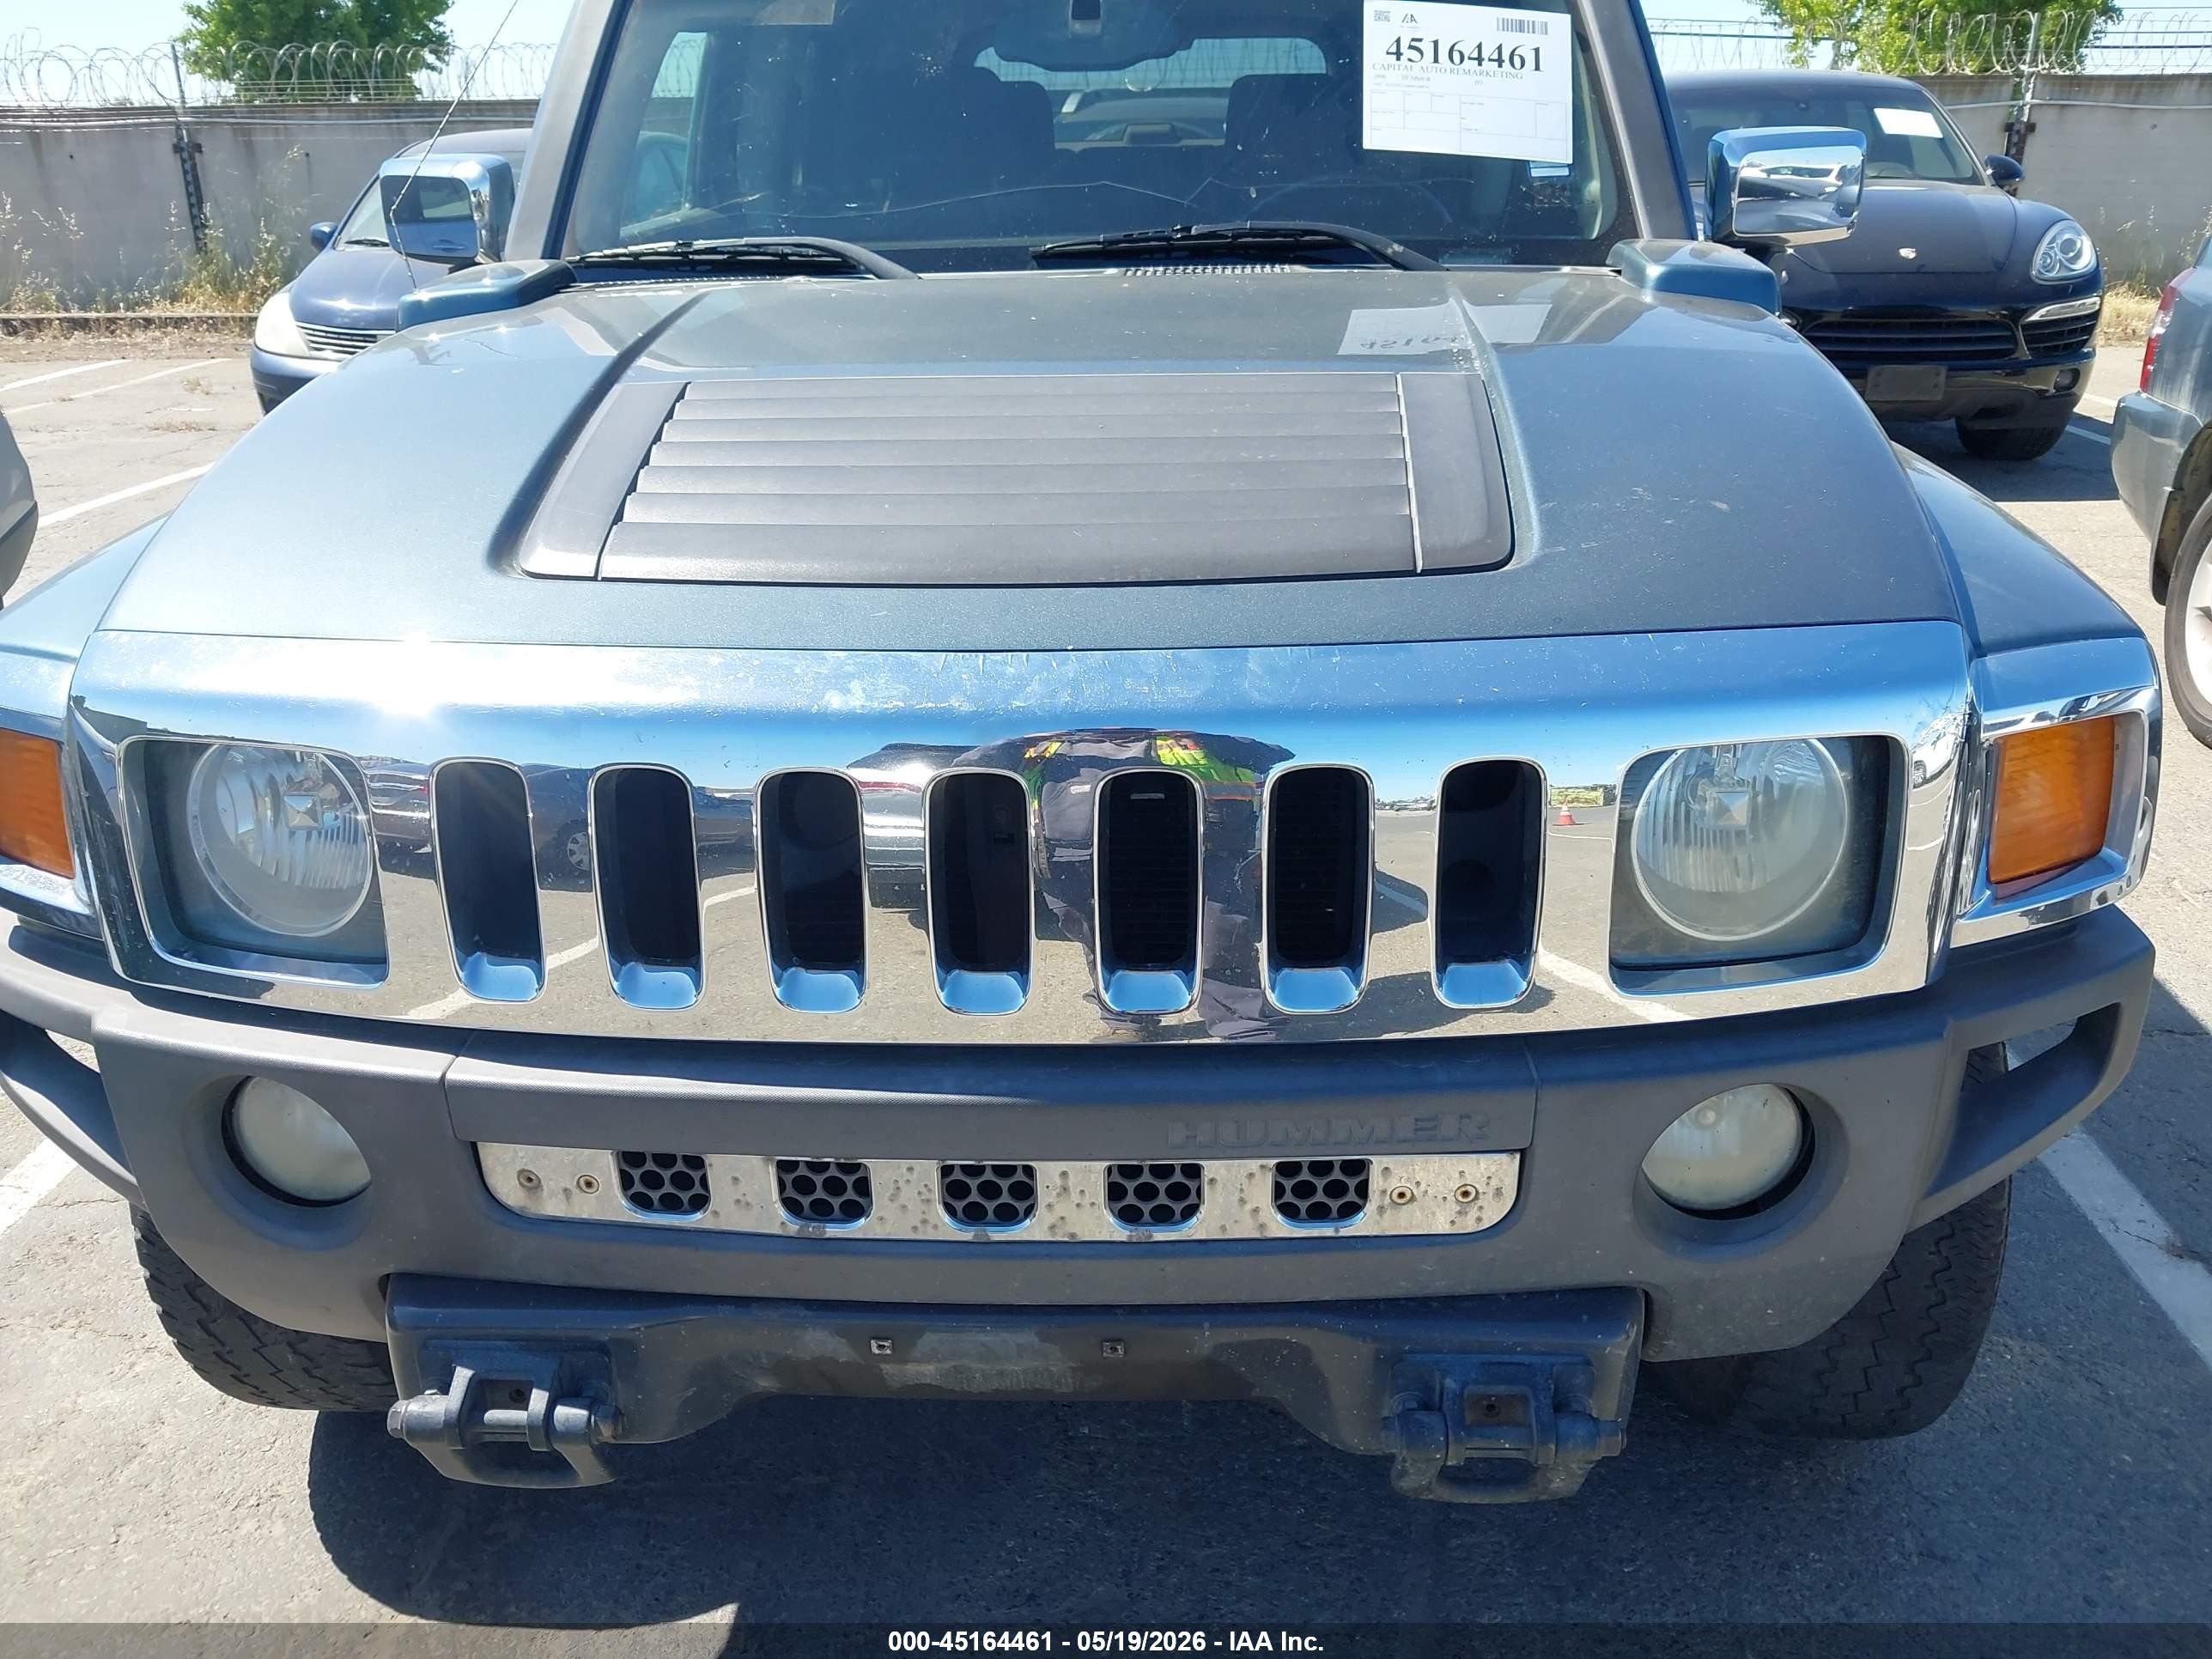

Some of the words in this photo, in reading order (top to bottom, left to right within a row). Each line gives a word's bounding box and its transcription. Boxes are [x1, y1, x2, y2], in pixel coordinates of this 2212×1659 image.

[1386, 35, 1545, 72] 45164461
[1372, 63, 1414, 73] CAPITAL
[1419, 65, 1447, 76] AUTO
[1449, 67, 1523, 81] REMARKETING
[1166, 1114, 1492, 1149] HUMMER
